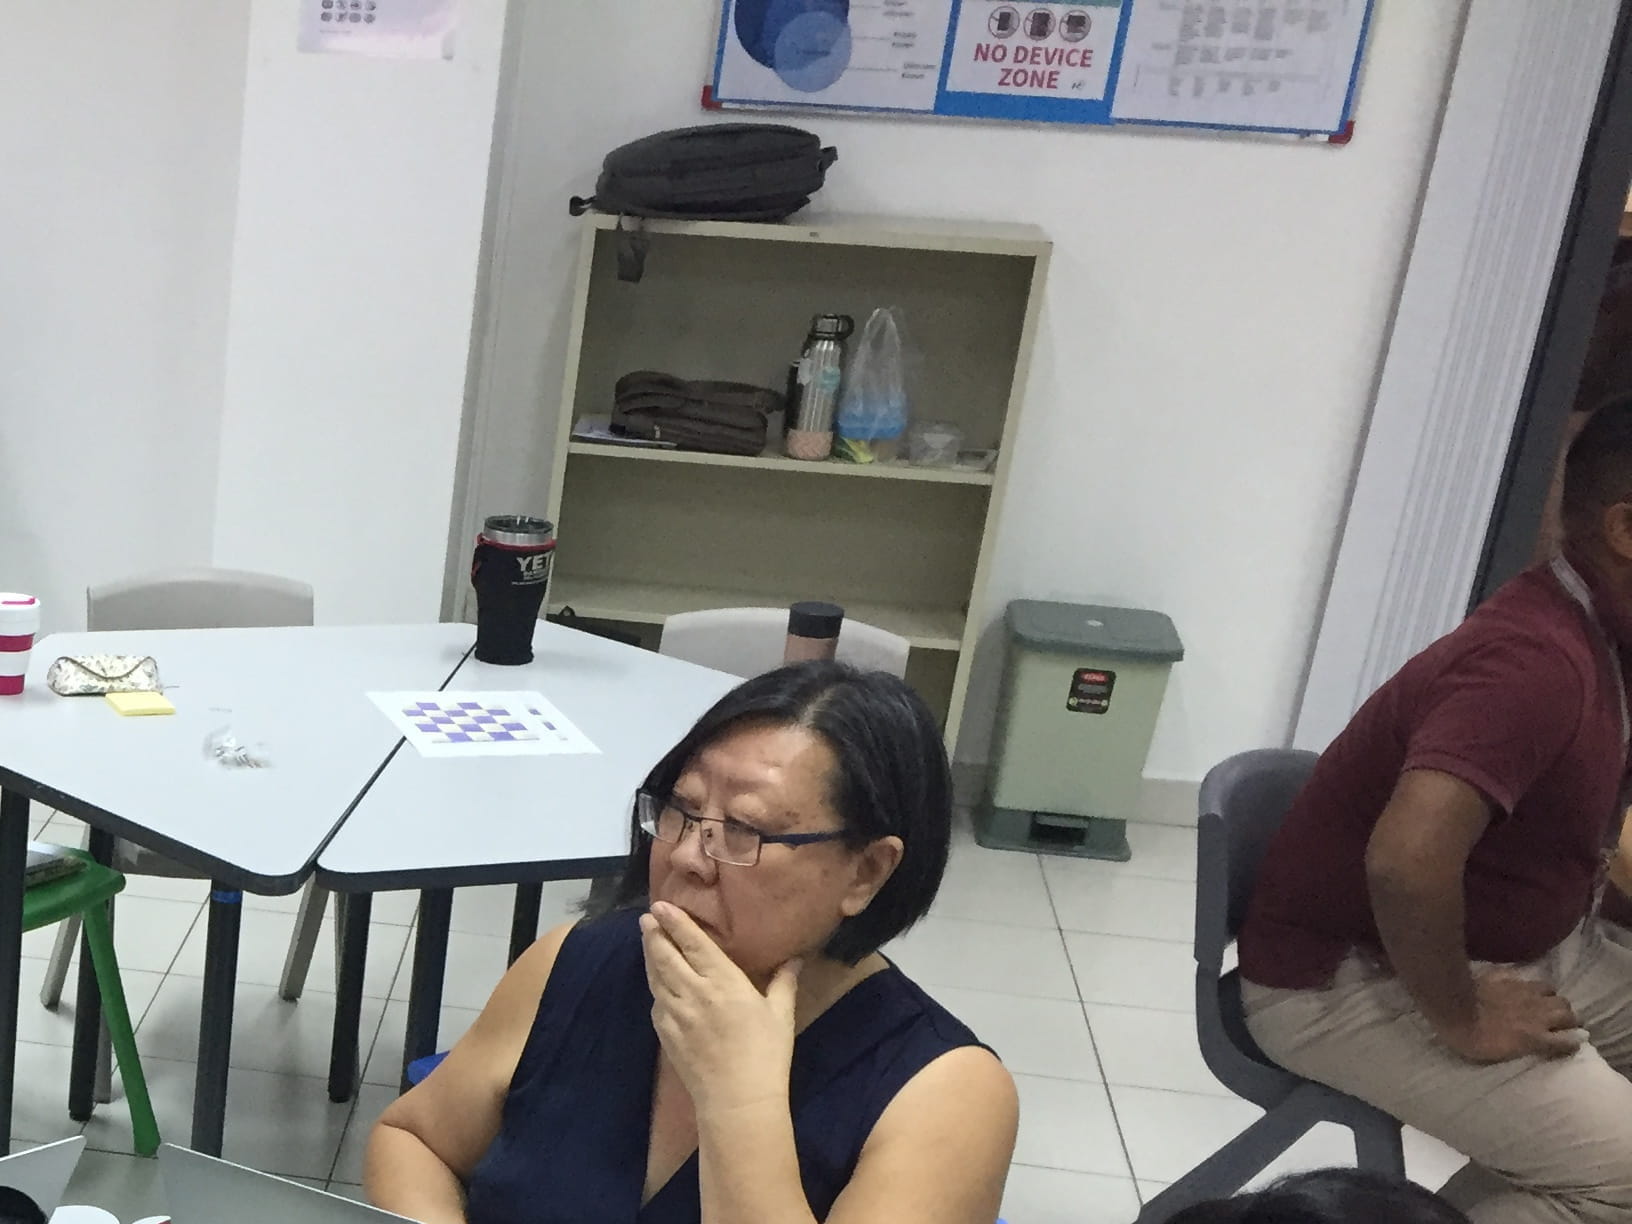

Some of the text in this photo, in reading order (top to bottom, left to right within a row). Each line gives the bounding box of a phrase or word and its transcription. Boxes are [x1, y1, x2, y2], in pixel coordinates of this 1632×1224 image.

[974, 43, 1093, 68] NO DEVICE
[998, 68, 1060, 89] ZONE
